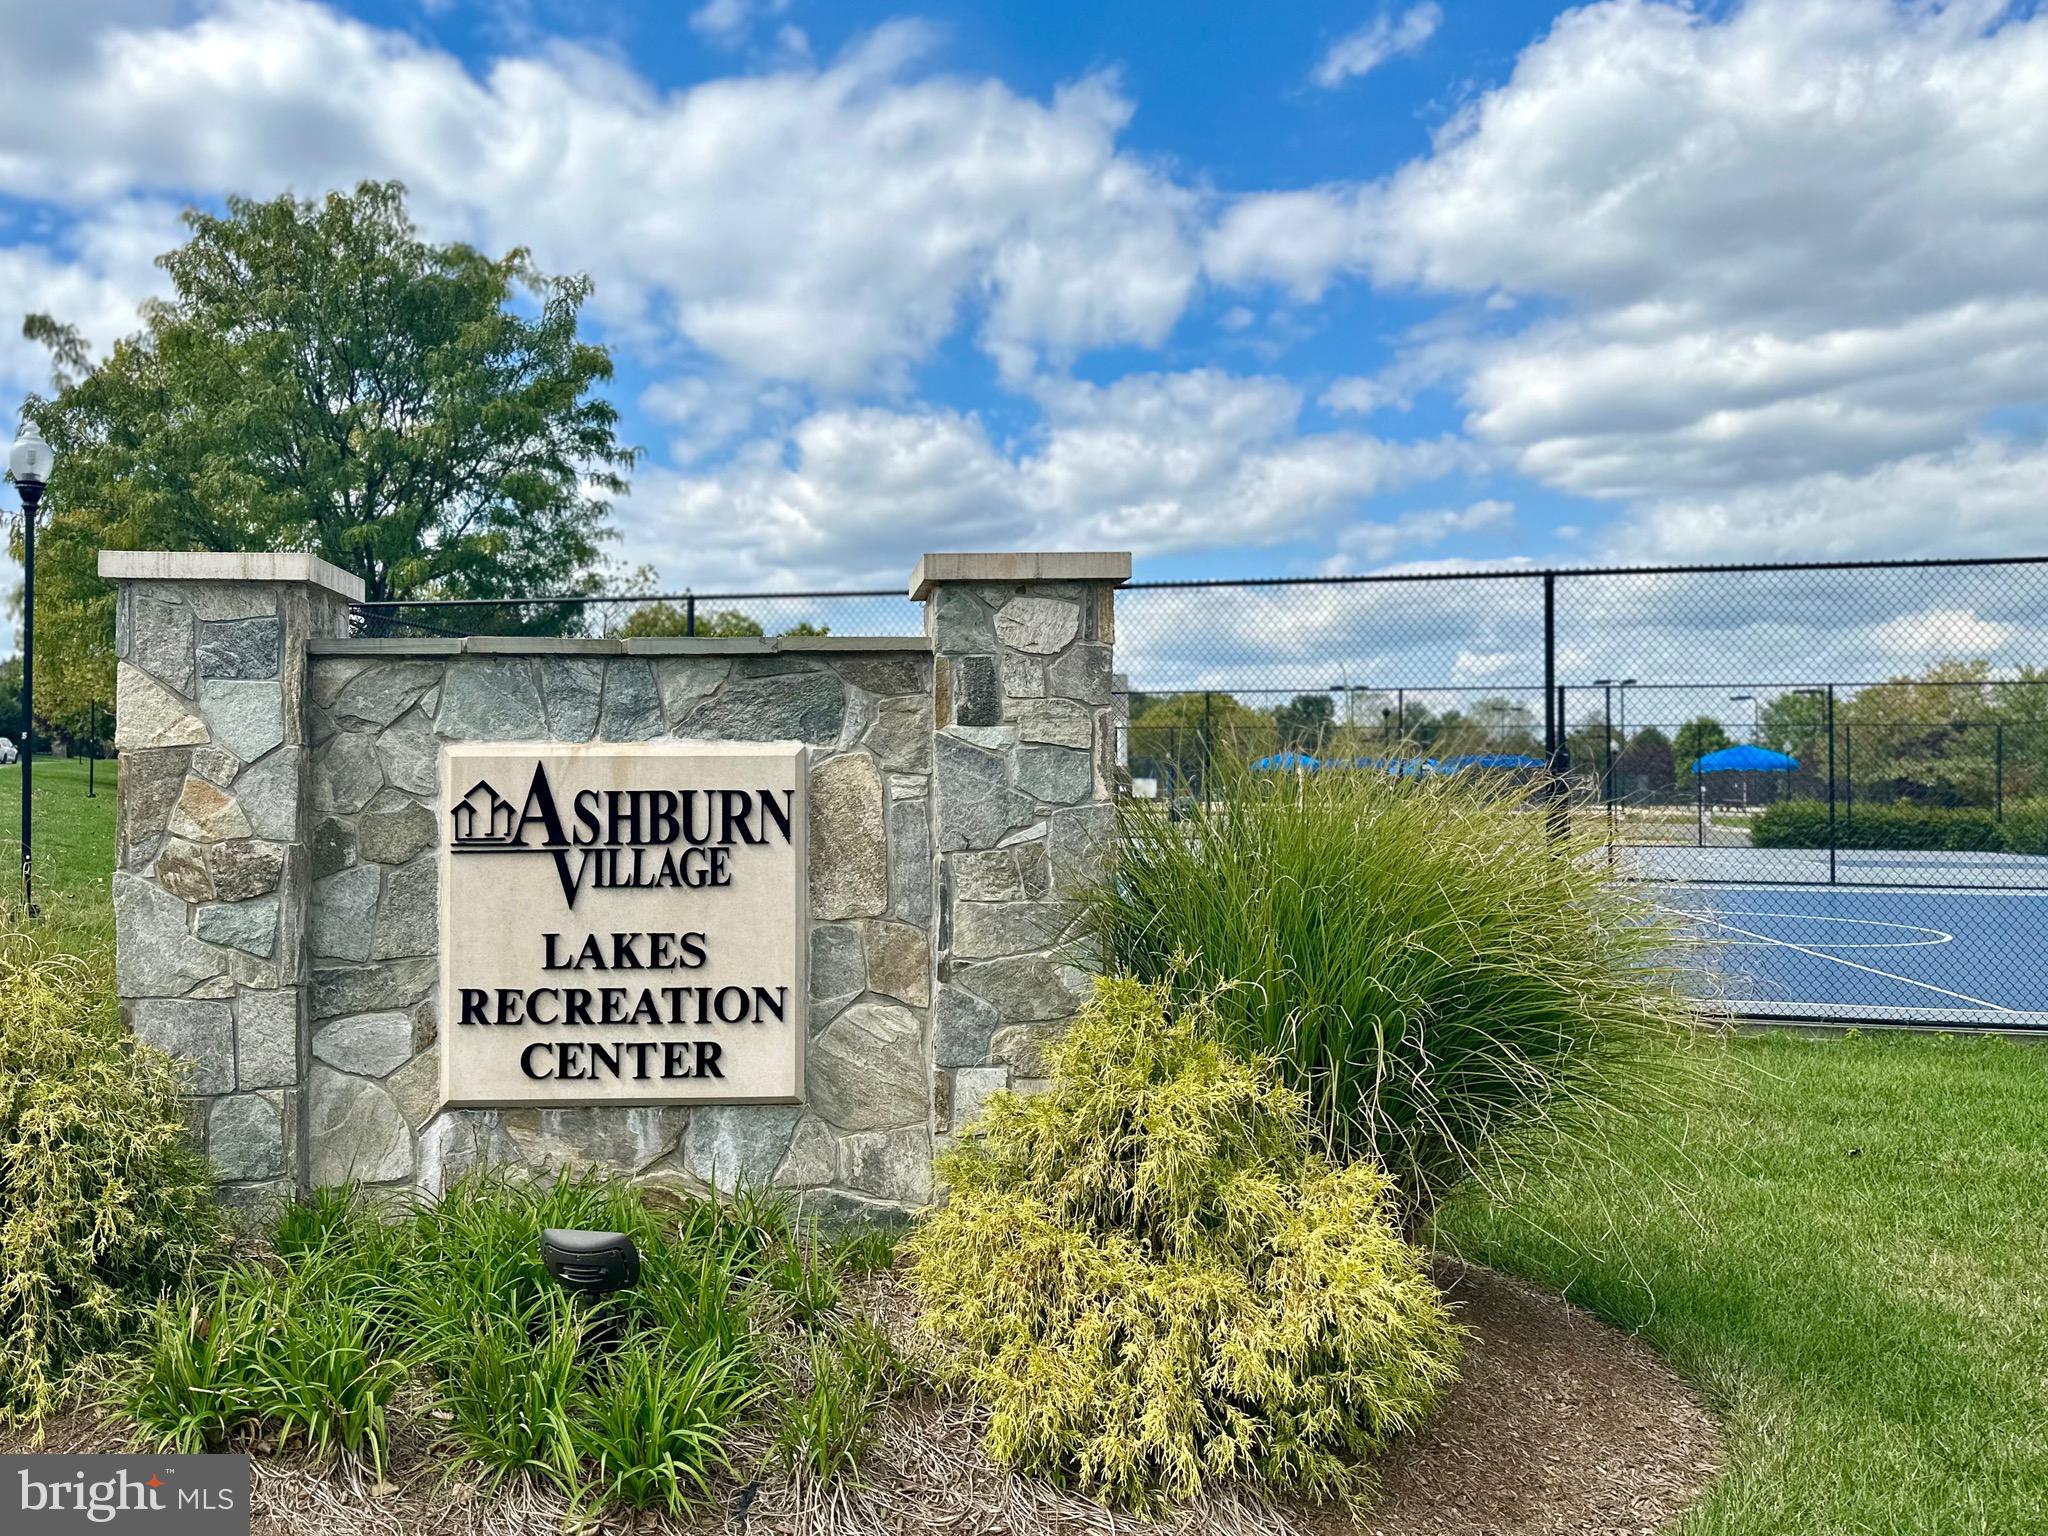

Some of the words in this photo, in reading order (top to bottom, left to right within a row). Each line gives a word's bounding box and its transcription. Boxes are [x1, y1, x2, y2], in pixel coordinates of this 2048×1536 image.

[513, 760, 795, 847] ASHBURN
[551, 847, 732, 910] VILLAGE
[542, 932, 707, 970] LAKES
[457, 986, 788, 1025] RECREATION
[520, 1041, 725, 1080] CENTER
